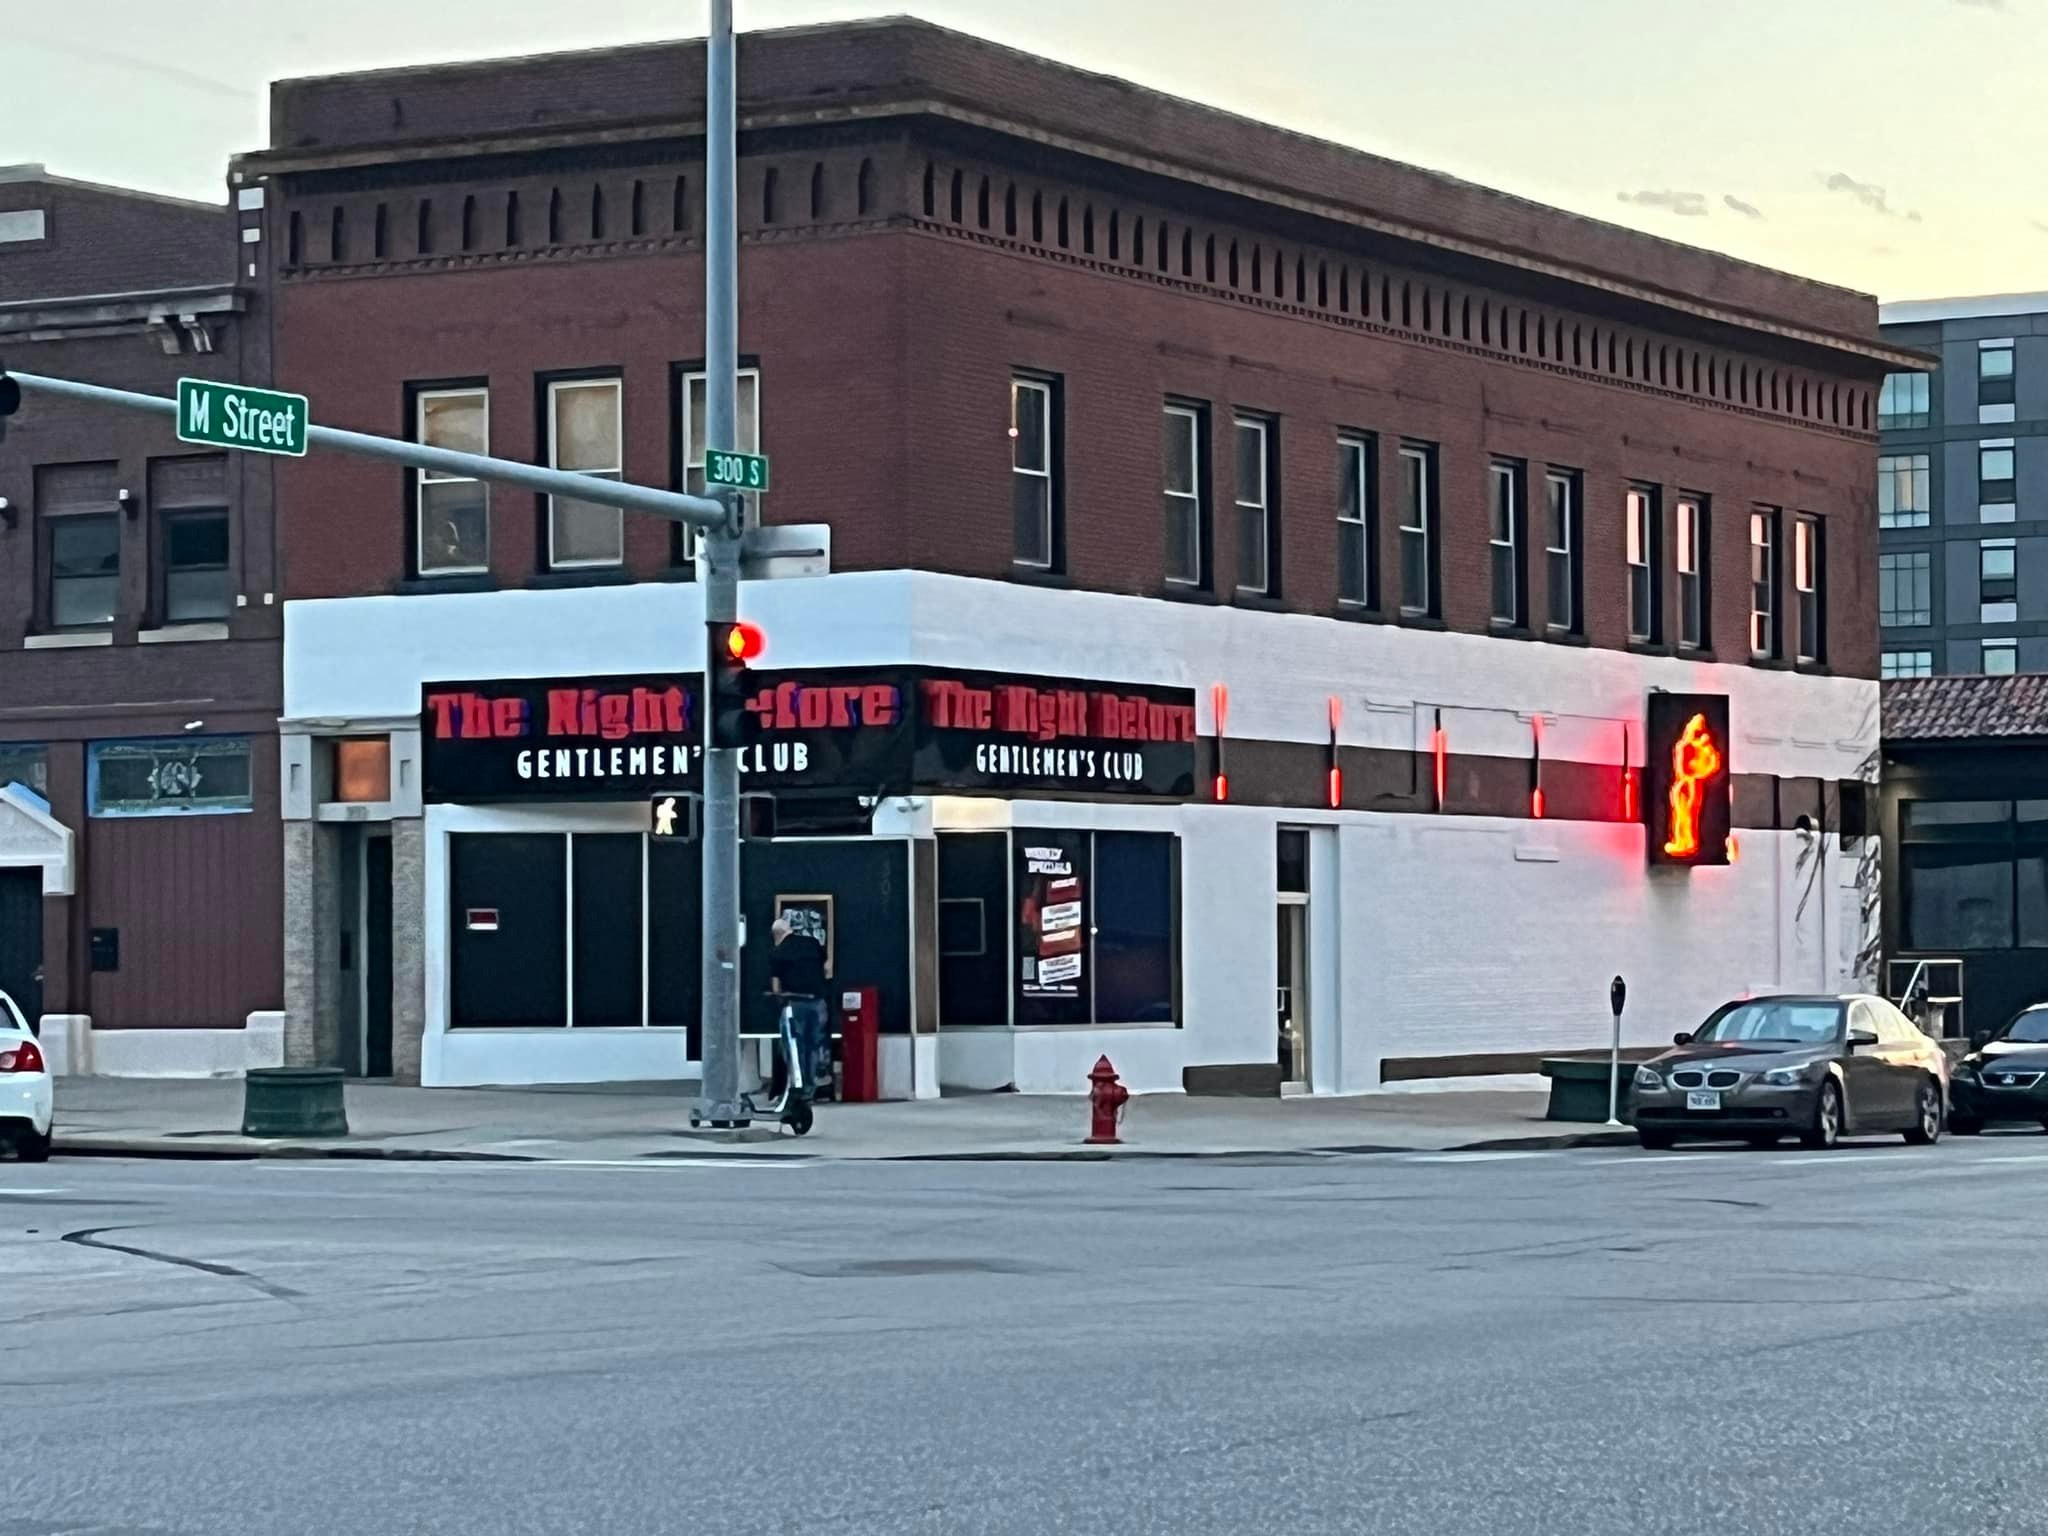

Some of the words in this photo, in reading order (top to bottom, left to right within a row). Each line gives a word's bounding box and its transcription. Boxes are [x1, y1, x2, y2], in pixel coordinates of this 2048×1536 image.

[190, 389, 209, 433] M
[222, 394, 295, 446] Street
[714, 456, 743, 483] 300
[750, 460, 759, 485] S
[427, 692, 521, 739] The
[547, 687, 685, 740] Night
[517, 745, 700, 779] GENTLEMEN'
[737, 742, 809, 773] CLUB
[976, 744, 1096, 778] GENTLEMEN'S
[1103, 751, 1143, 781] CLUB
